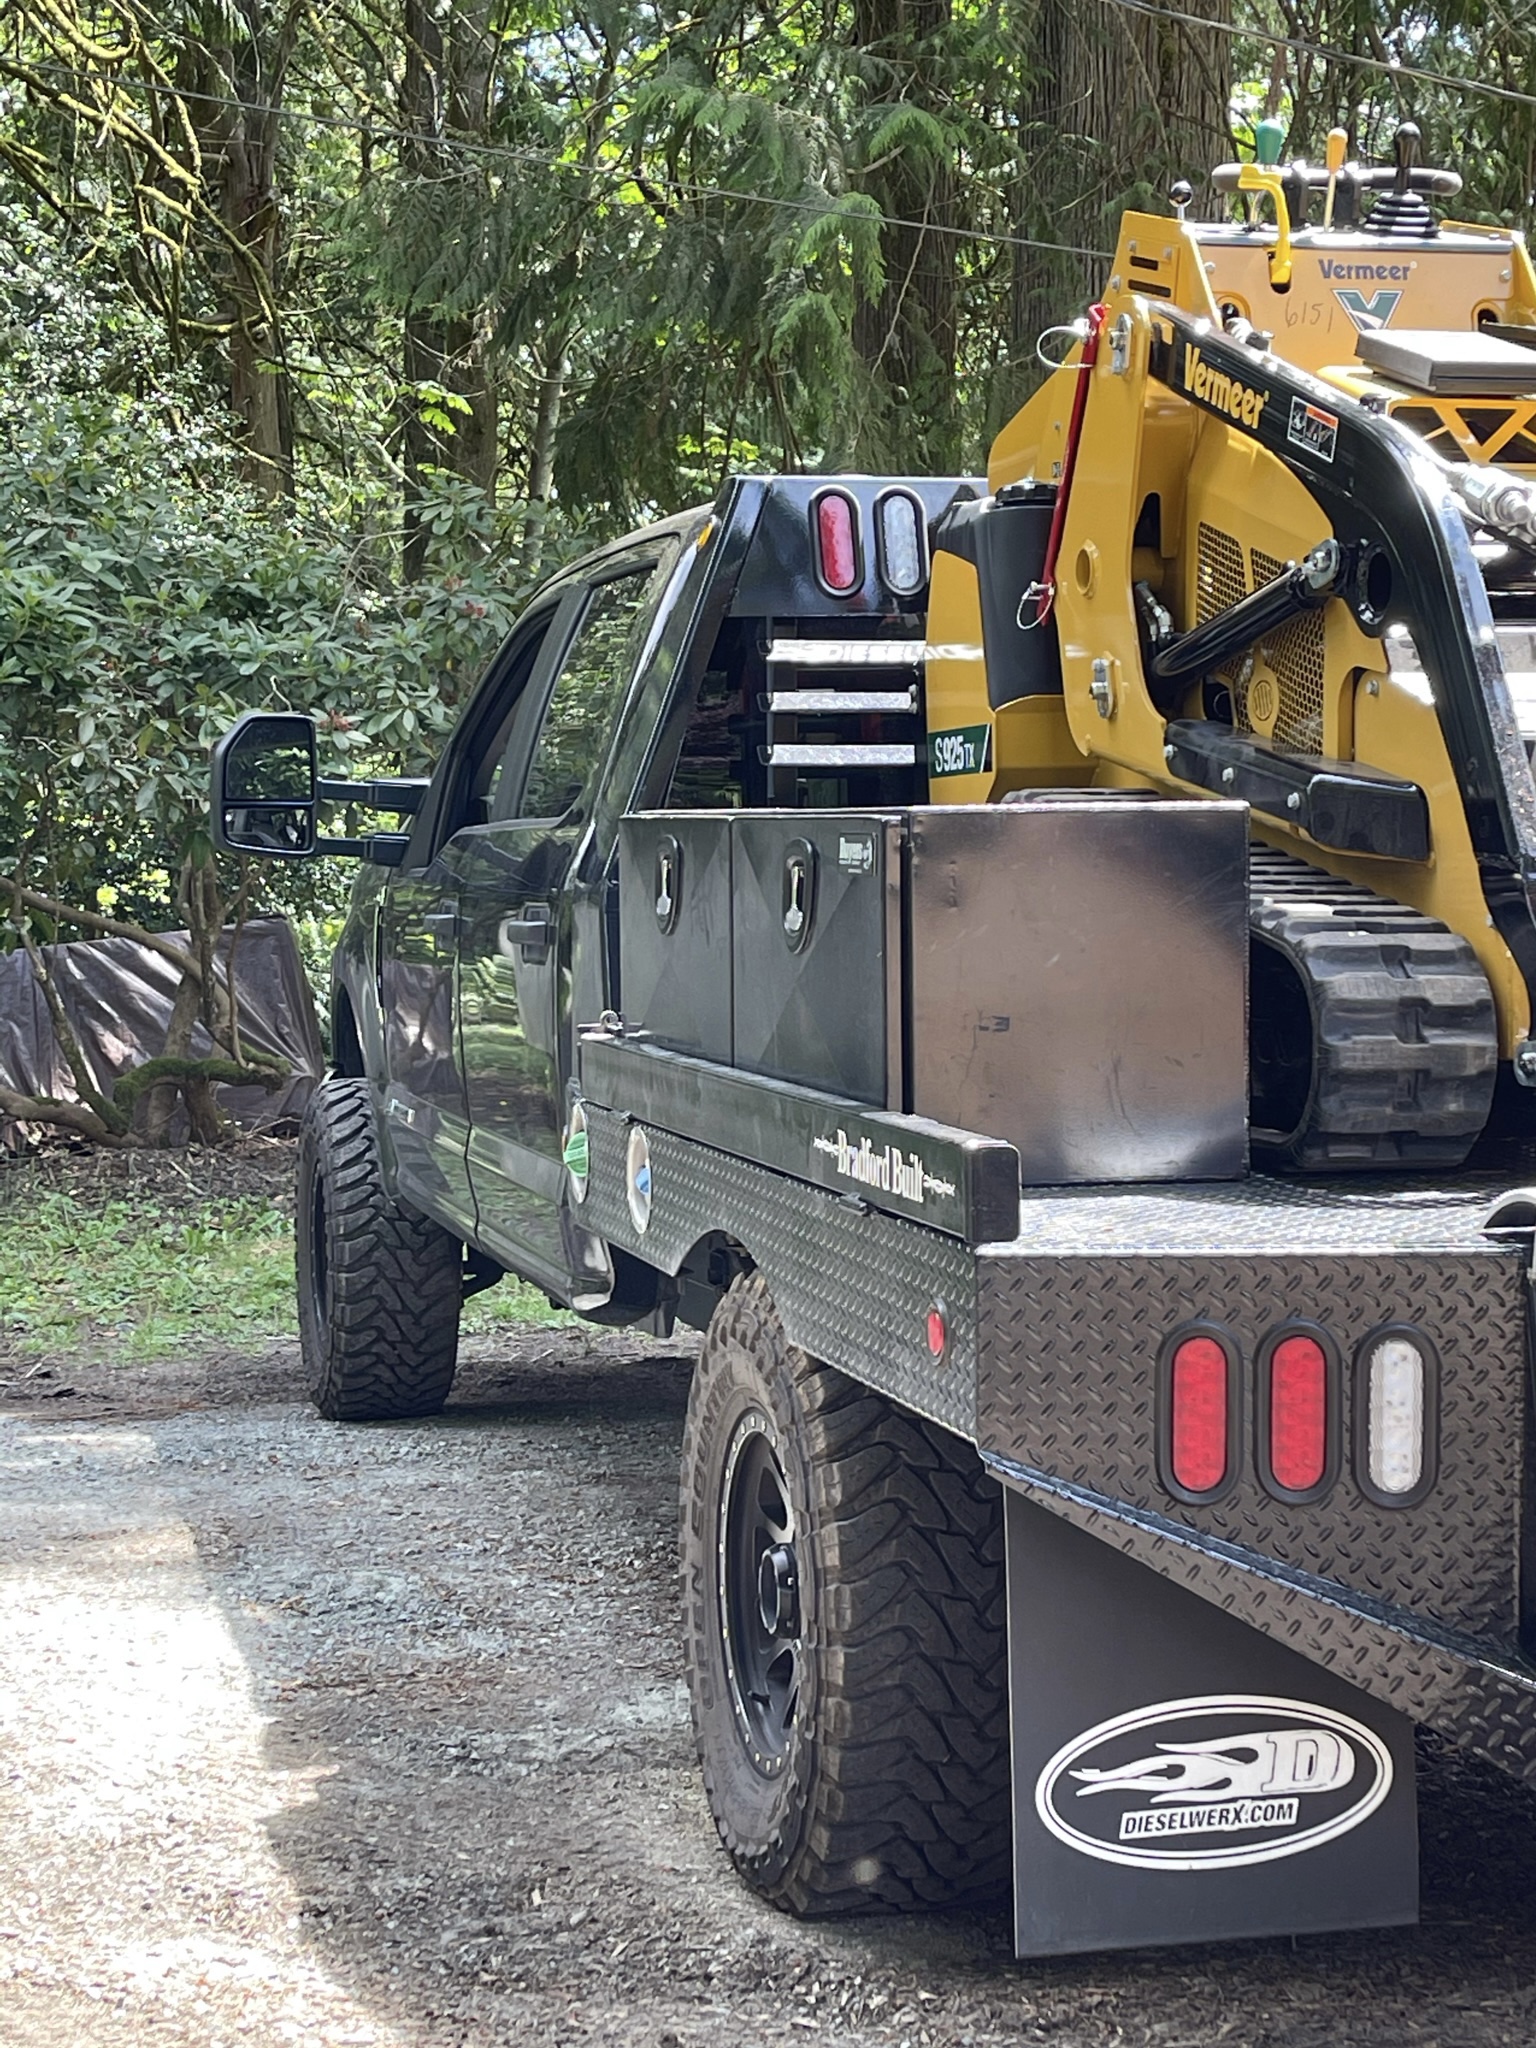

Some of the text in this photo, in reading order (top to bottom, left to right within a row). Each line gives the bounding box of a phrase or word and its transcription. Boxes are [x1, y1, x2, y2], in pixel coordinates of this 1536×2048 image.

[1319, 259, 1411, 281] Vermeer
[1183, 342, 1266, 430] Vermeer
[1124, 1801, 1294, 1835] DIESELWERX.COM
